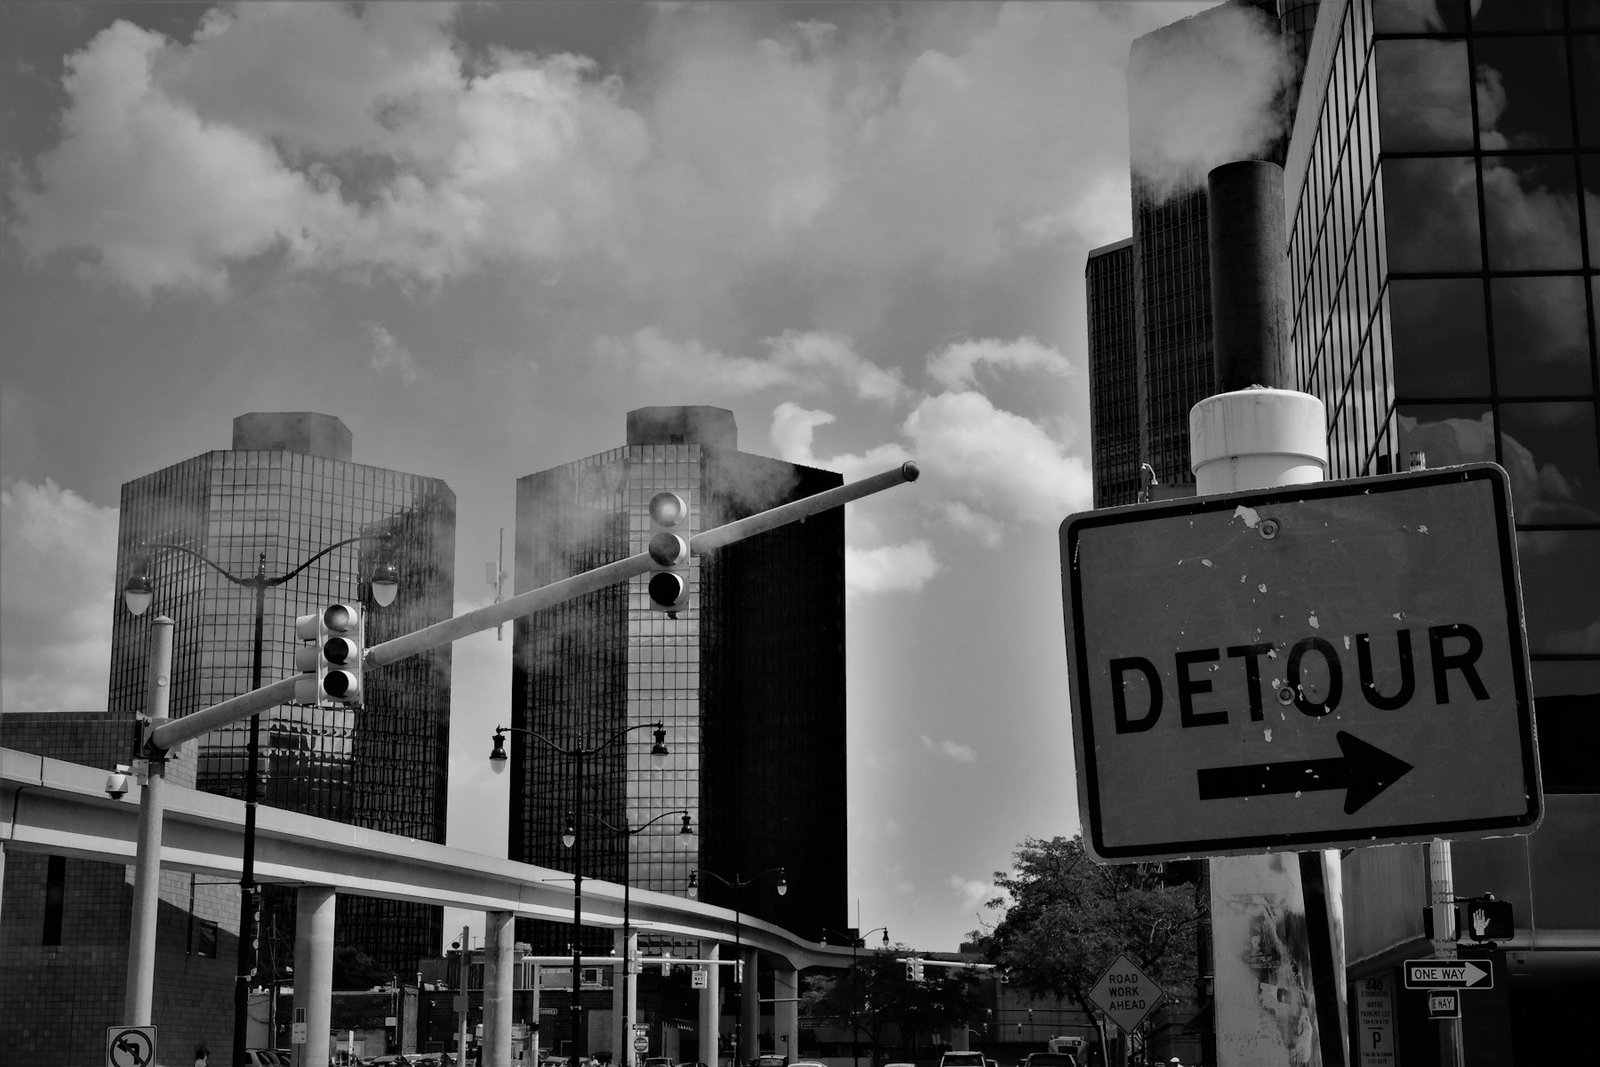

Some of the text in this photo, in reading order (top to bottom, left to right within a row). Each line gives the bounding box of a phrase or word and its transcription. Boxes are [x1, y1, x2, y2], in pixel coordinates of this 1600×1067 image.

[1109, 623, 1491, 735] DETOUR
[1109, 974, 1138, 984] ROAD
[1414, 969, 1466, 979] ONE WAY
[1109, 987, 1139, 997] WORK
[1109, 1000, 1145, 1011] AHEAD
[1372, 1031, 1382, 1049] P
